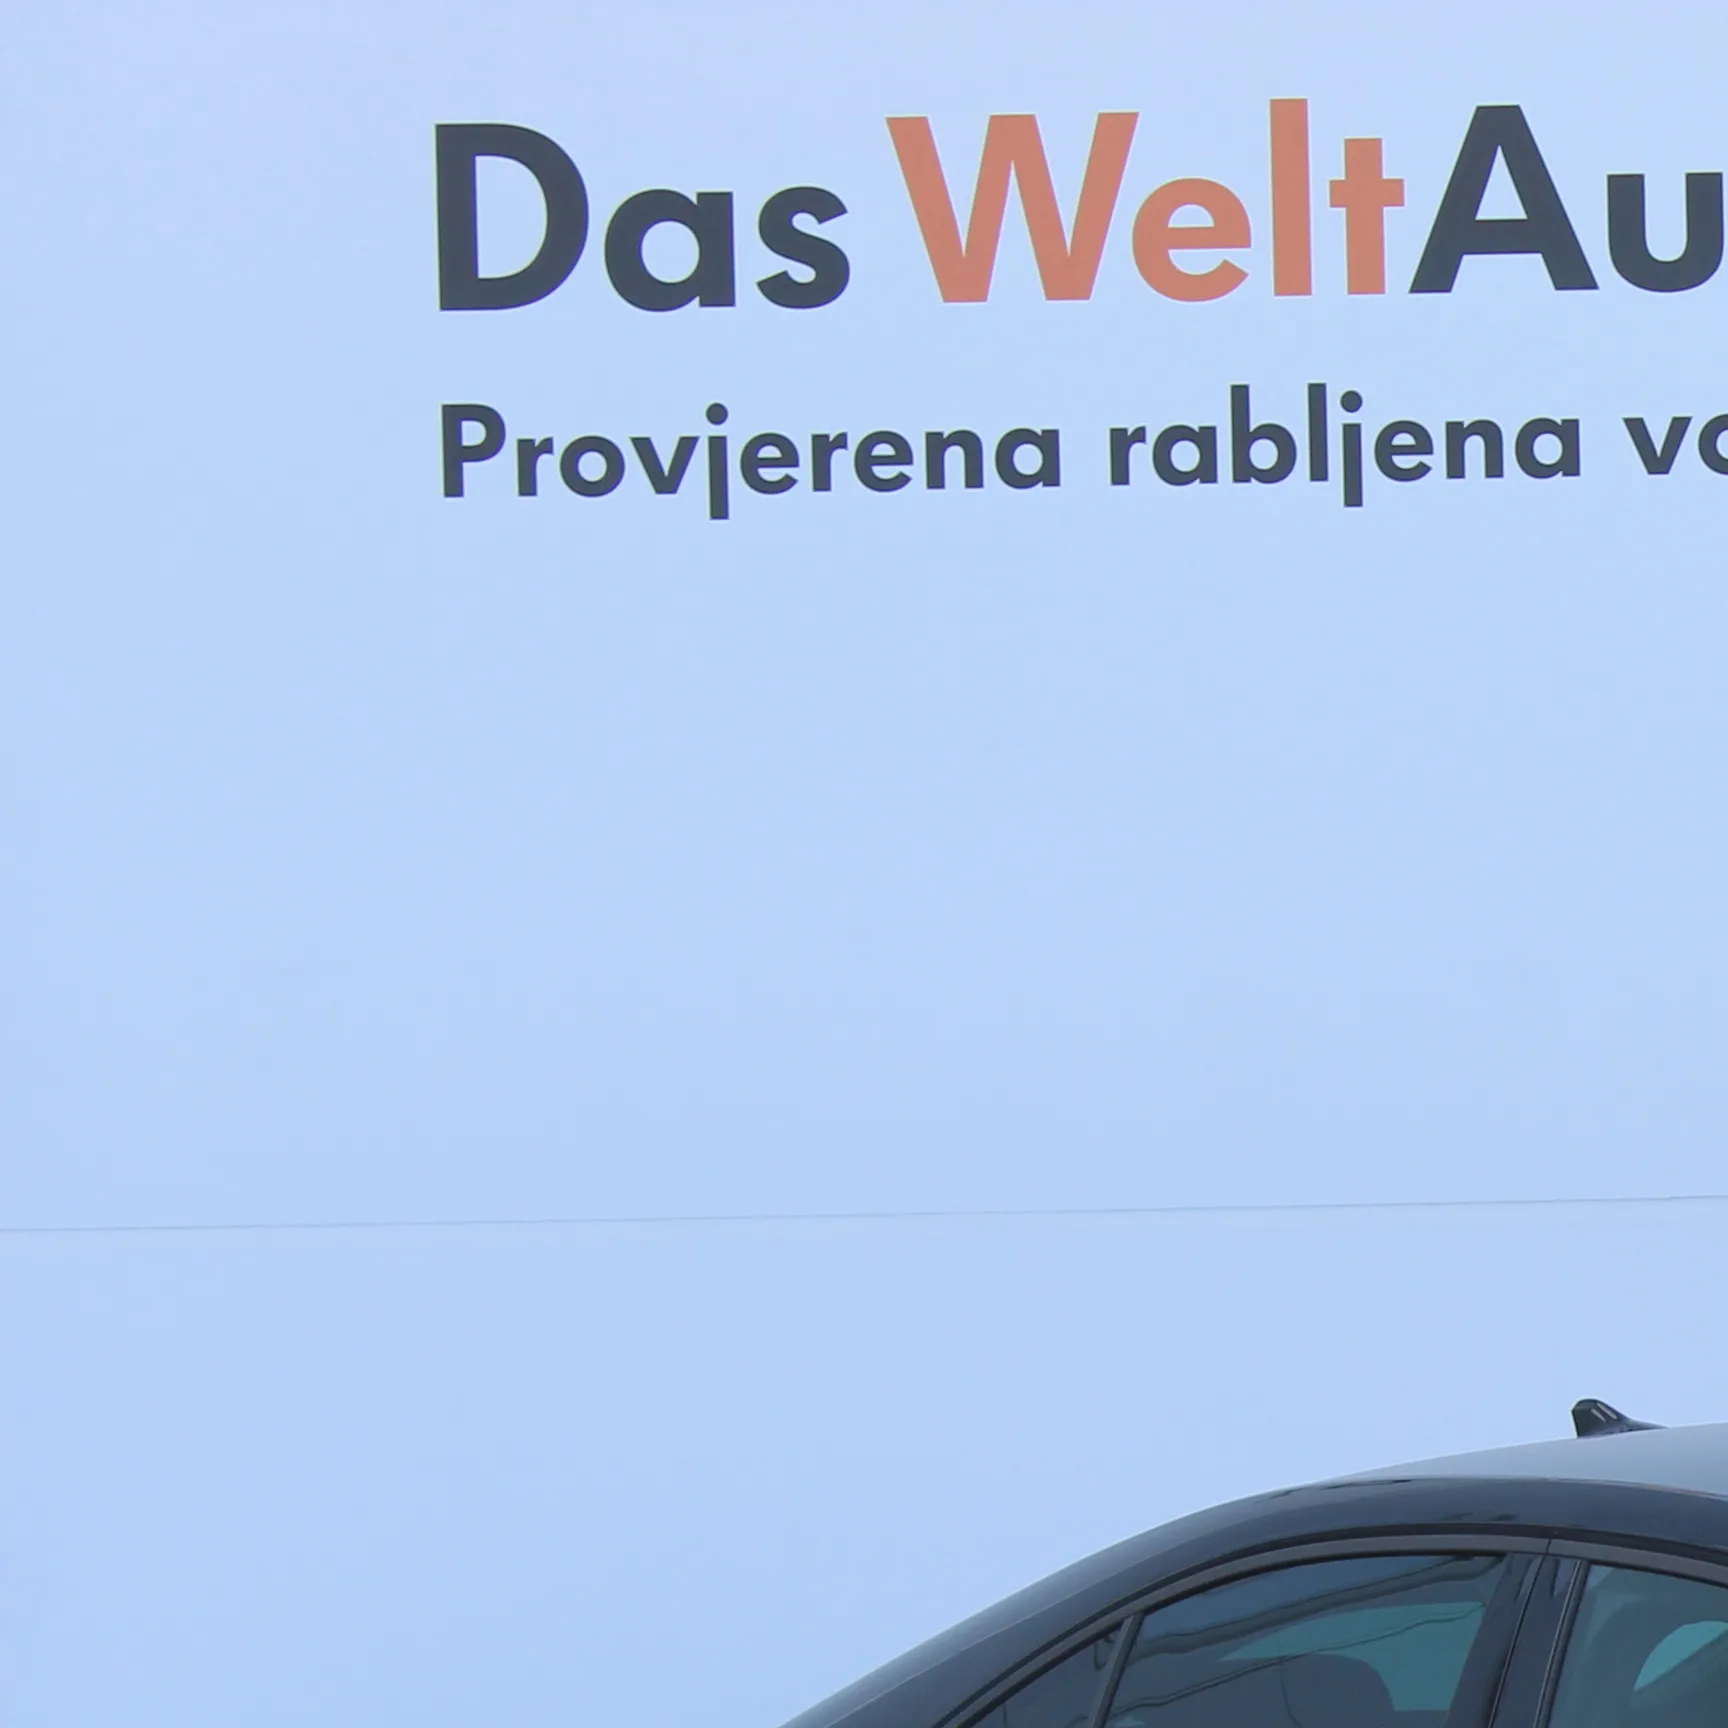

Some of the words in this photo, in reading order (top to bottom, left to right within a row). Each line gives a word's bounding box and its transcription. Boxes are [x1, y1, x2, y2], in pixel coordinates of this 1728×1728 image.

[434, 122, 850, 313] Das
[440, 402, 1061, 521] Provjerena
[1108, 382, 1581, 508] rabljena
